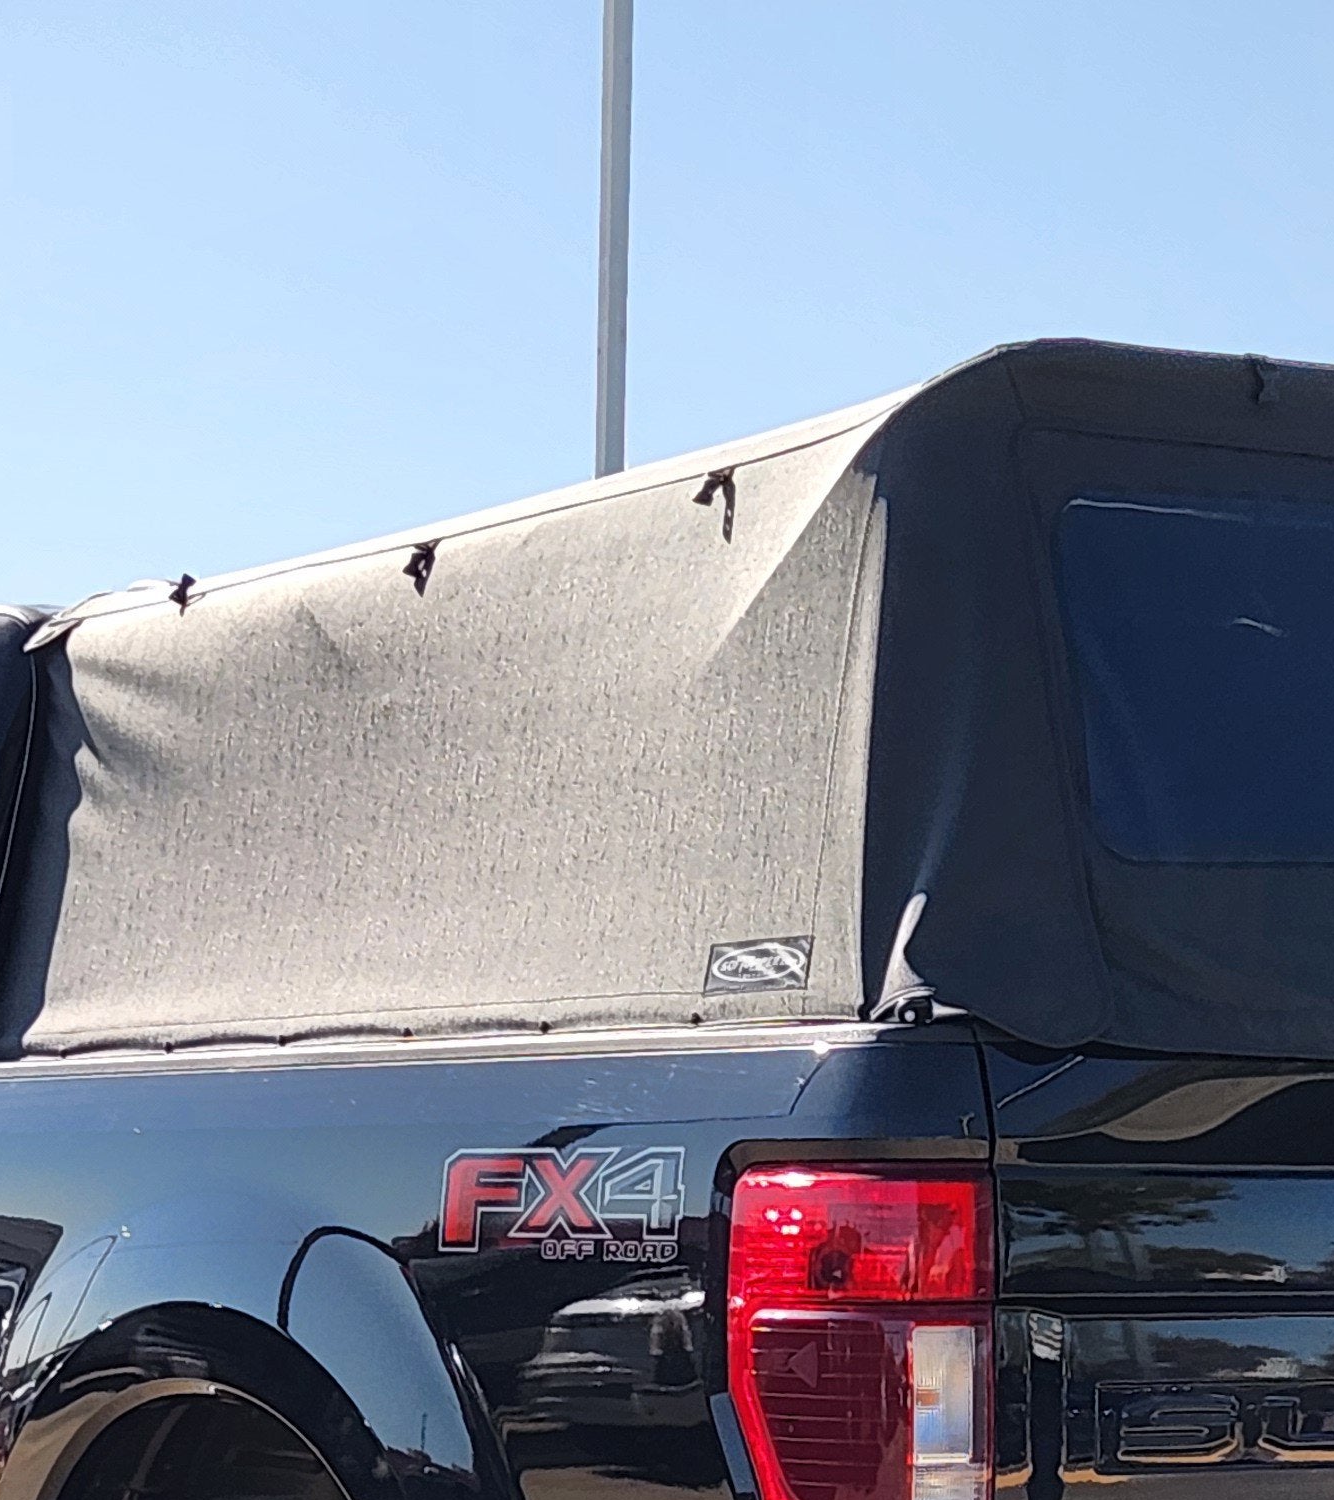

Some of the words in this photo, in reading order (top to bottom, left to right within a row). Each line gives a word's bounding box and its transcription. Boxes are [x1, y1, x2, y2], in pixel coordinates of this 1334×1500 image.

[438, 1147, 685, 1252] FX4
[541, 1240, 594, 1260] OFF
[603, 1240, 678, 1262] ROAD
